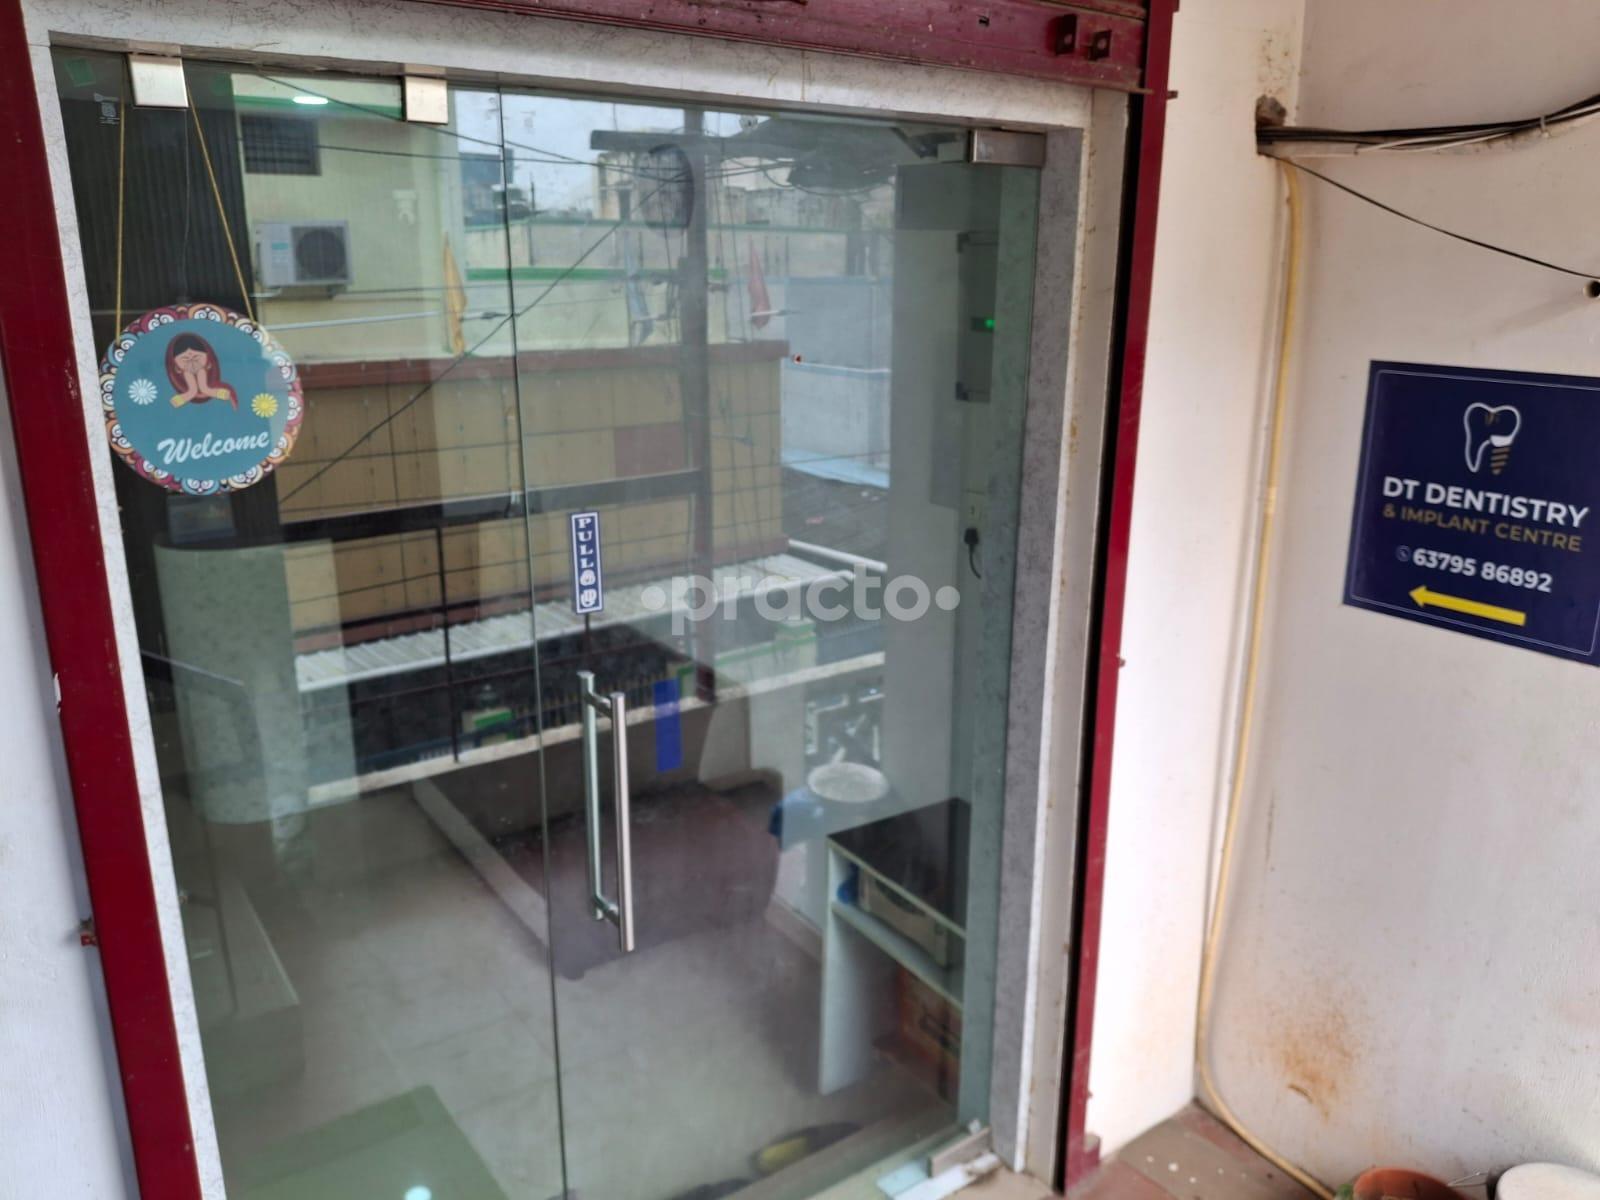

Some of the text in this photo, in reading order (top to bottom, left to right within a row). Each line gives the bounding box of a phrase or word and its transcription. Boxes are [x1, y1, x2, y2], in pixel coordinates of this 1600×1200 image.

[157, 431, 270, 465] Welcome
[1383, 476, 1589, 528] DT DENTISTRY
[577, 517, 594, 569] PULL
[1383, 503, 1582, 552] & IMPLANT CENTRE
[1412, 548, 1552, 593] 63795 86892
